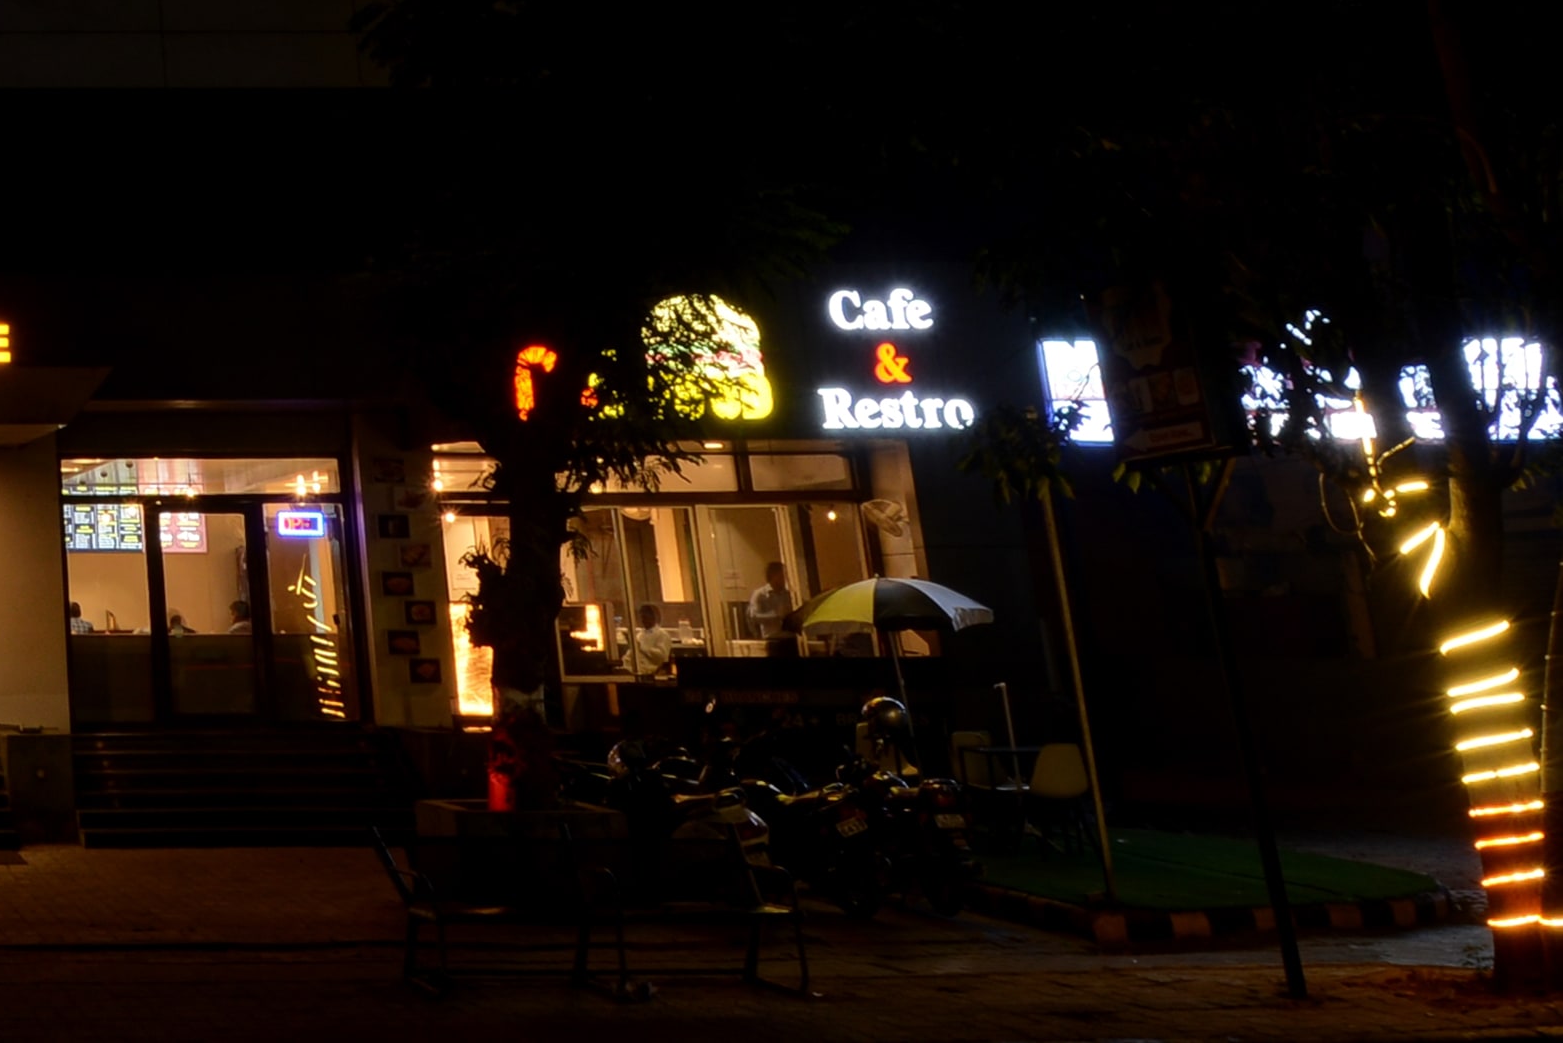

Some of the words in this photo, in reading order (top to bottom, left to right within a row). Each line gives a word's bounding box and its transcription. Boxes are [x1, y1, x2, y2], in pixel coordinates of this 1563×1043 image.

[828, 288, 934, 332] Cafe
[875, 342, 912, 384] &
[817, 386, 975, 431] Restro
